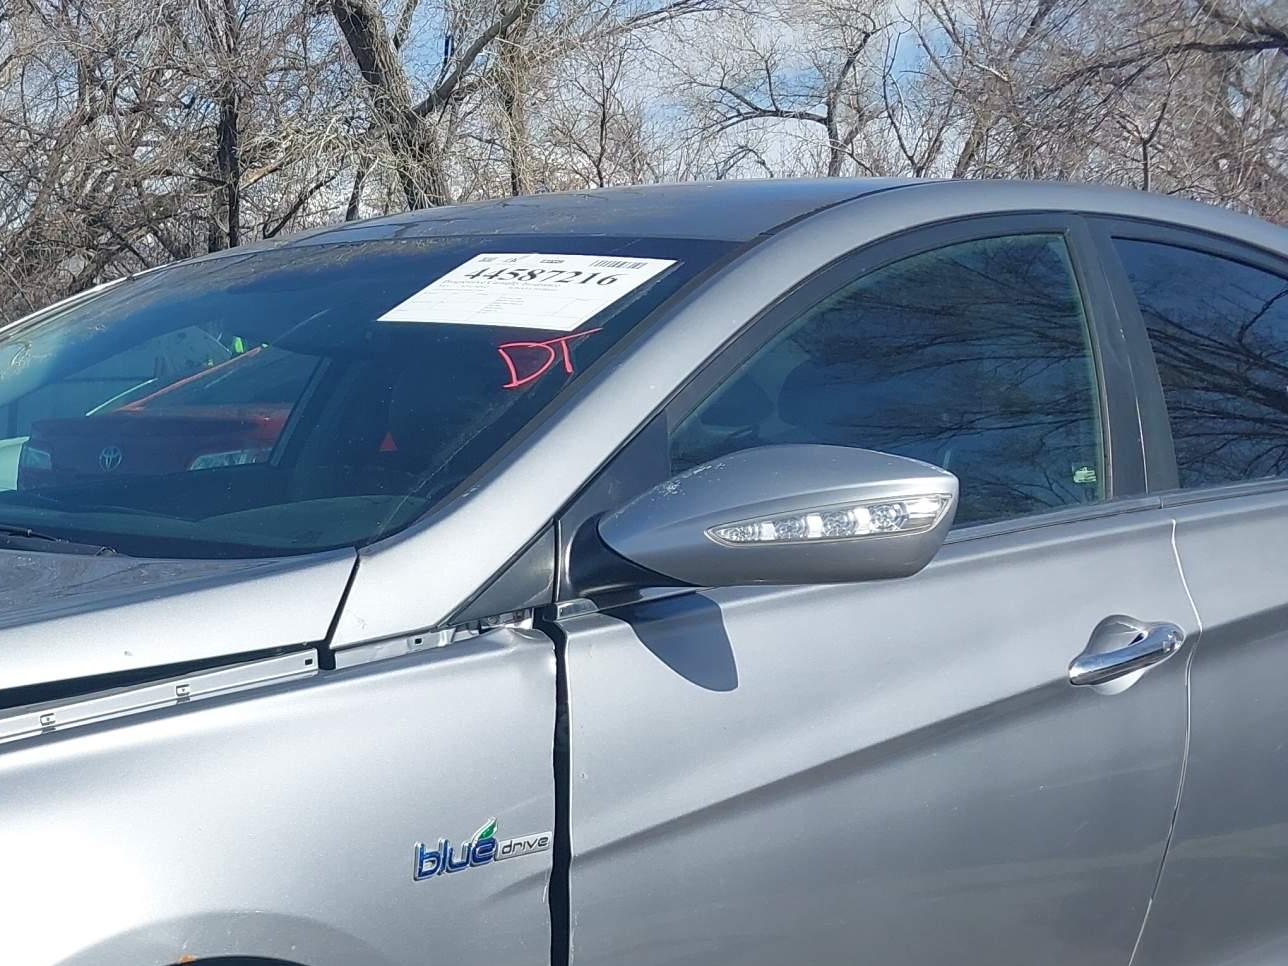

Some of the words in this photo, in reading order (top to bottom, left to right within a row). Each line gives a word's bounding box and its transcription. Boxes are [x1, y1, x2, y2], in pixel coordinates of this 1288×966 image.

[464, 267, 623, 286] 44587216
[414, 836, 498, 881] blue
[501, 835, 550, 855] drive
